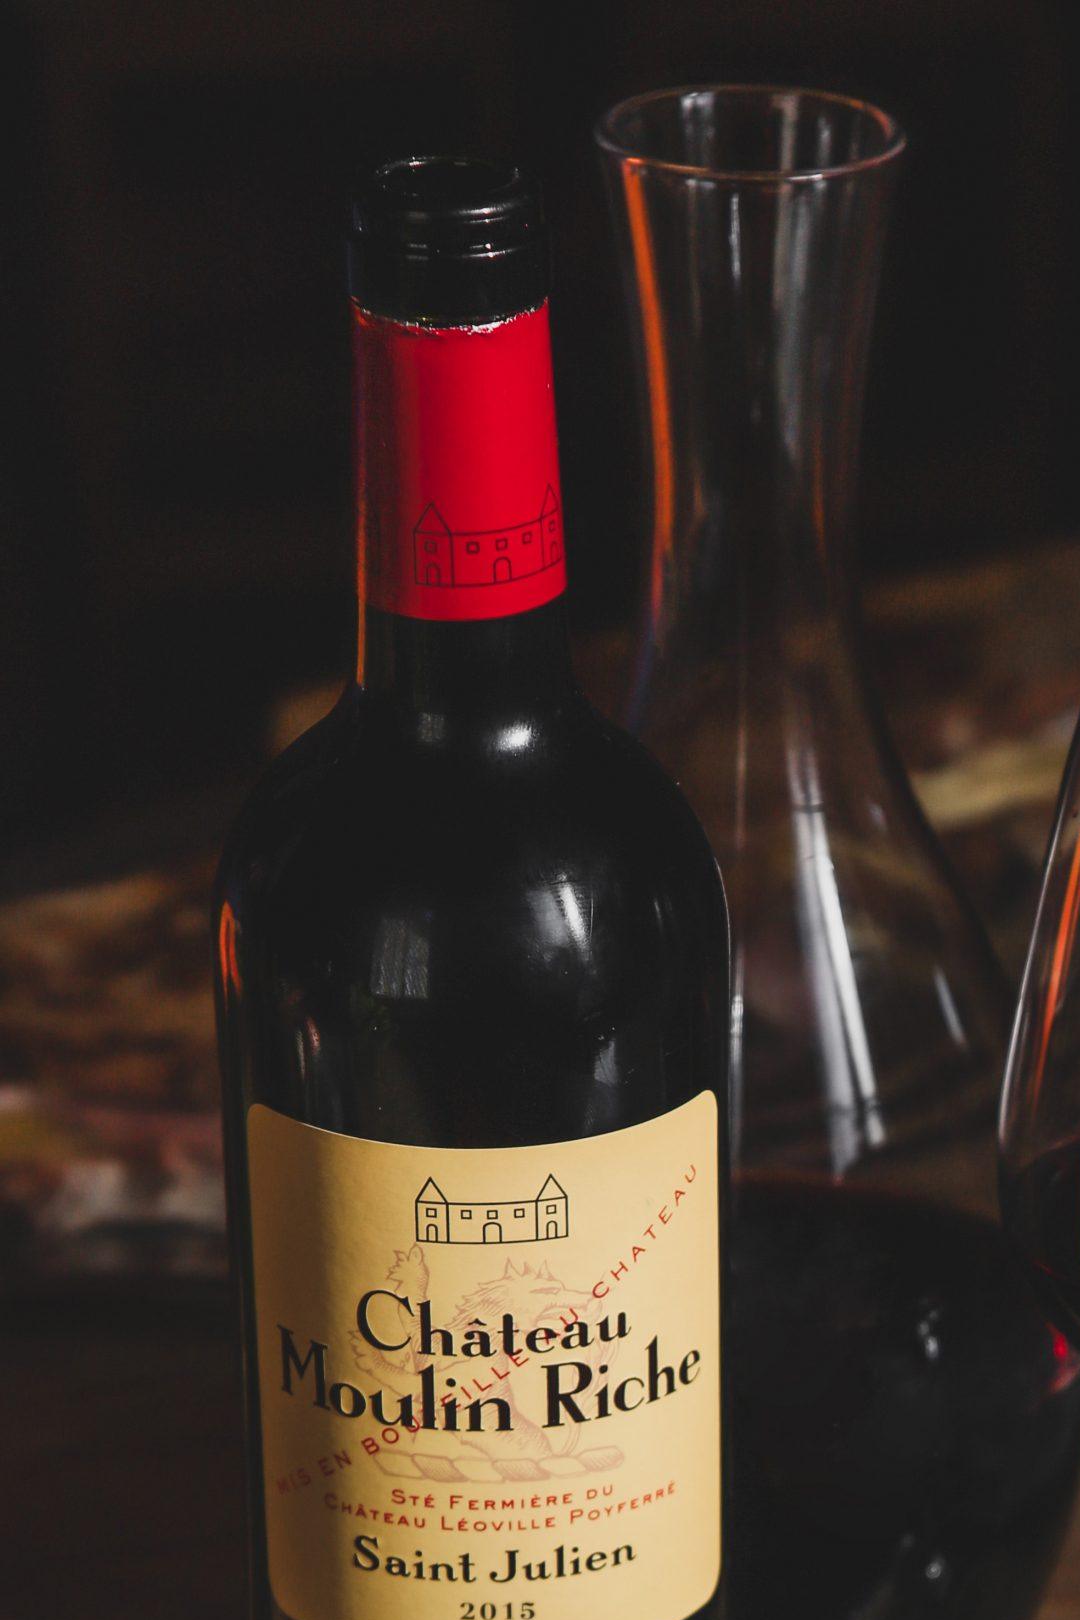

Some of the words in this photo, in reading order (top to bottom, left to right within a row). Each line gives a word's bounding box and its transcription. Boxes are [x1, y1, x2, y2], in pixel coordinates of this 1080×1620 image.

[318, 1449, 352, 1478] EN
[361, 1347, 530, 1456] BOUEILLE
[592, 1164, 697, 1299] CHATEAU
[356, 1289, 631, 1358] Château
[277, 1324, 514, 1432] Moulin
[541, 1336, 701, 1429] Riche
[324, 1492, 427, 1529] CHÂTEAU
[441, 1515, 556, 1533] LÉOVILLE
[570, 1480, 676, 1525] POYFERRÉ
[391, 1488, 436, 1509] STÉ
[449, 1492, 573, 1511] FERMIÈRE
[586, 1483, 614, 1501] DU
[352, 1535, 477, 1583] Saint
[489, 1540, 637, 1584] Julien
[460, 1601, 537, 1620] 2015
